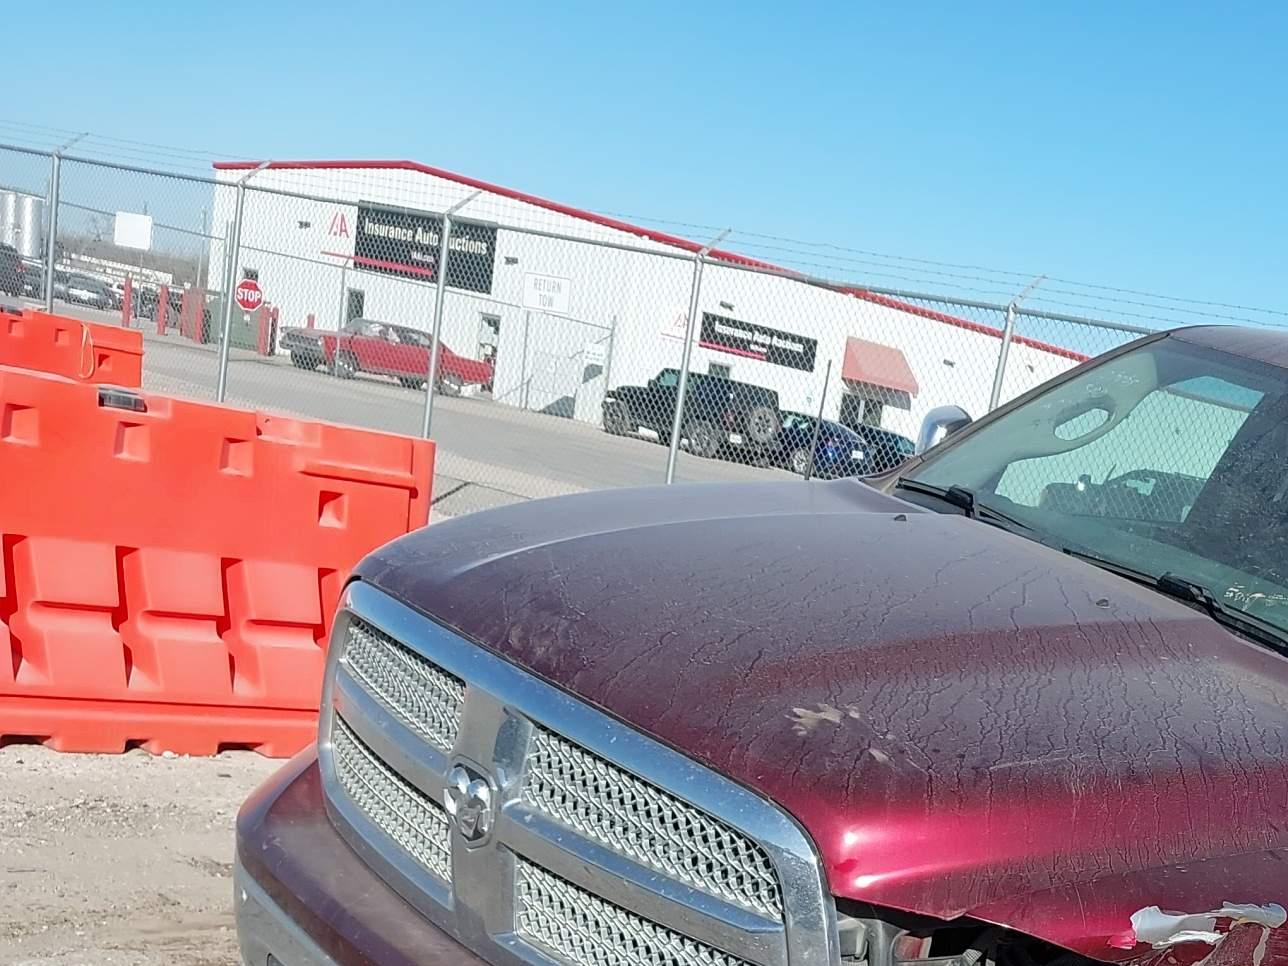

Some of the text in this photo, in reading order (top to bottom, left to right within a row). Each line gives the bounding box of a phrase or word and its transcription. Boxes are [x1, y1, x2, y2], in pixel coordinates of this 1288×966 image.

[364, 218, 488, 255] Insurance Auto uctions
[237, 287, 262, 303] STOP
